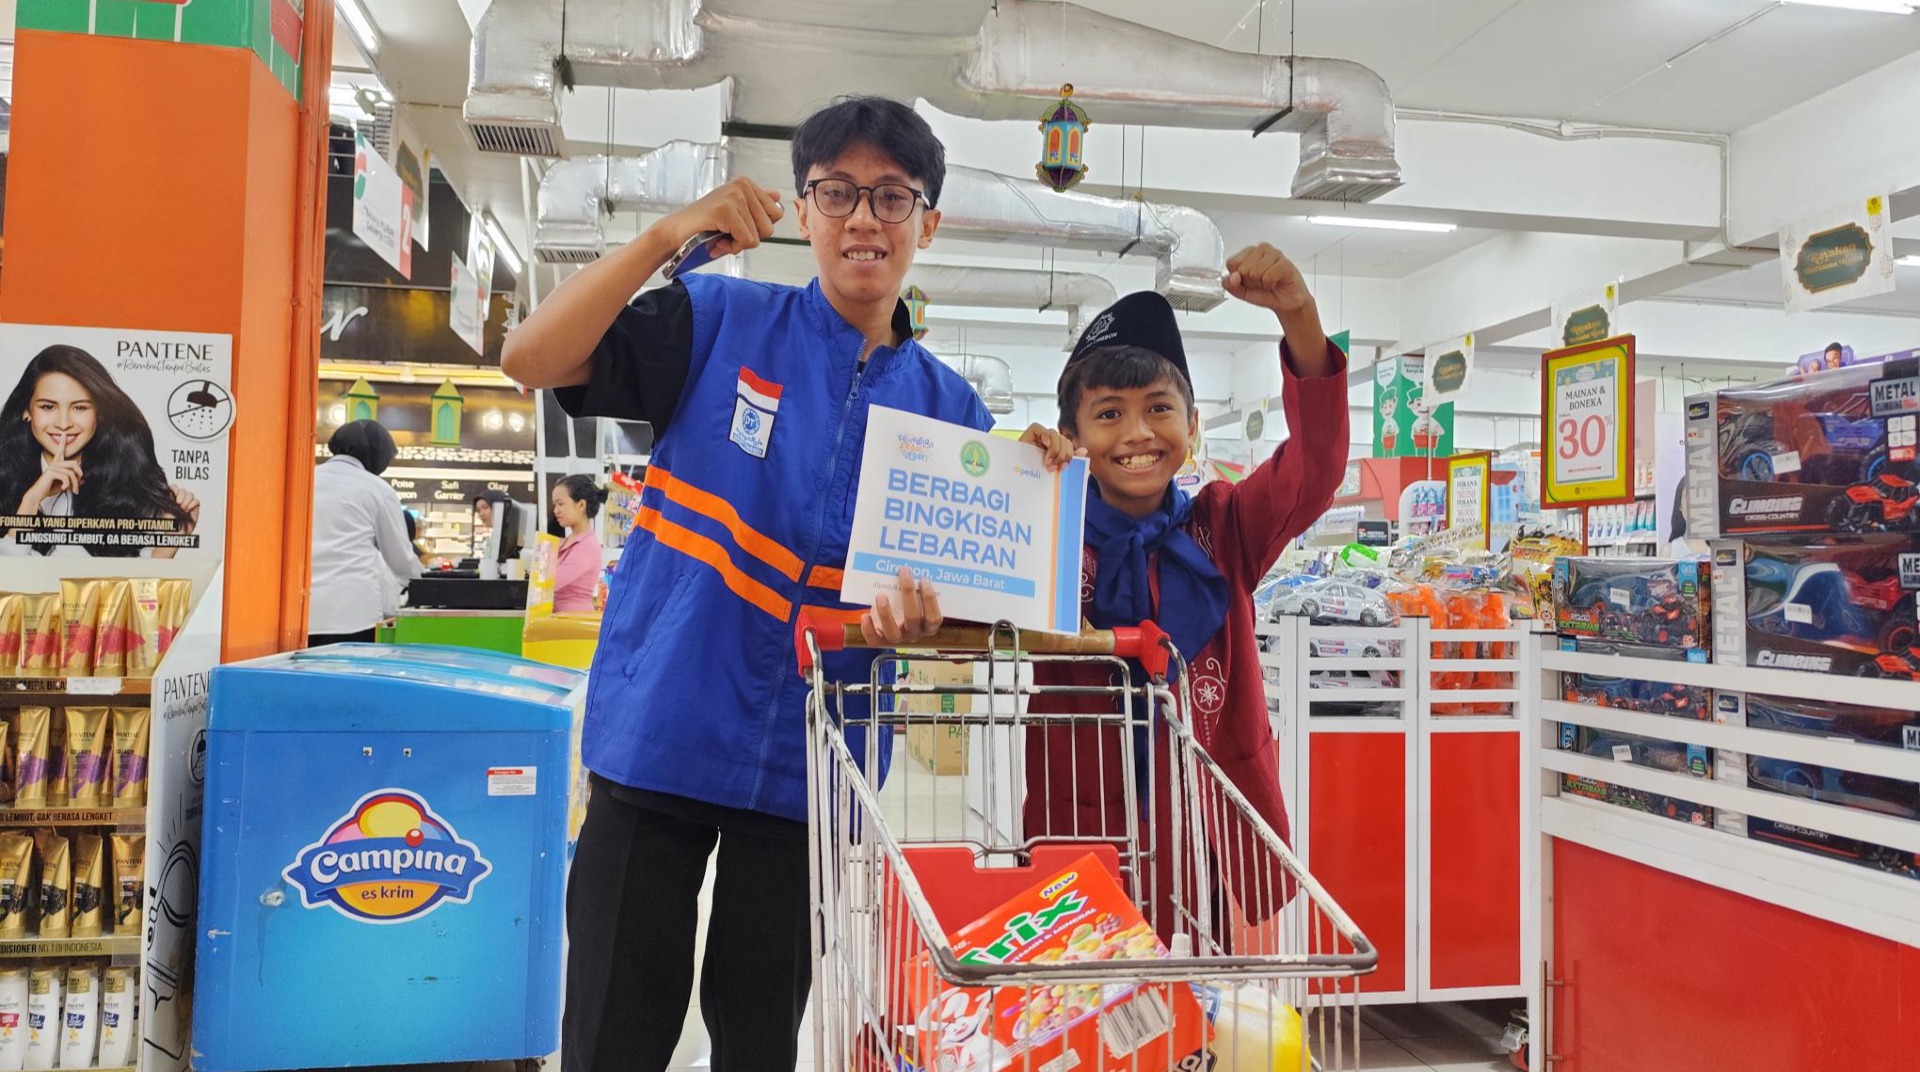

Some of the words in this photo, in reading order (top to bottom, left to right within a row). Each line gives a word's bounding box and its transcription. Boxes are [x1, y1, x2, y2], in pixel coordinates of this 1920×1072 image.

[117, 340, 213, 361] PANTENE
[1565, 387, 1598, 400] MAINAN
[1599, 385, 1606, 395] &
[1876, 382, 1916, 401] METAL
[1569, 398, 1602, 411] BONEKA
[171, 449, 210, 465] TANPA
[175, 466, 209, 481] BILAS
[391, 479, 415, 489] Poise
[440, 480, 459, 490] Safi
[487, 482, 509, 492] Olay
[887, 468, 1010, 514] BERBAGI
[434, 491, 465, 500] Garnier
[0, 517, 41, 528] FORMULA
[42, 517, 66, 528] YANG
[67, 518, 116, 529] DIPERKAYA
[117, 519, 176, 531] PRO-VITAMIN.
[884, 497, 1032, 546] BINGKISAN
[1745, 513, 1800, 521] CROSS-COUNTRY
[20, 532, 66, 544] LANGSUNG
[68, 533, 105, 545] LEMBUT,
[107, 534, 120, 545] GA
[121, 535, 155, 546] BERASA
[156, 535, 196, 547] LENGKET
[879, 526, 1016, 570] LEBARAN
[936, 568, 970, 584] Jawa
[973, 574, 1006, 590] Barat
[53, 812, 80, 821] BERASA
[82, 811, 113, 821] LENGKET
[310, 849, 467, 884] Campina
[361, 889, 377, 900] es
[380, 886, 414, 899] krim
[1042, 873, 1076, 898] New
[1053, 907, 1098, 935] MINERAL
[64, 941, 103, 953] INDONESIA
